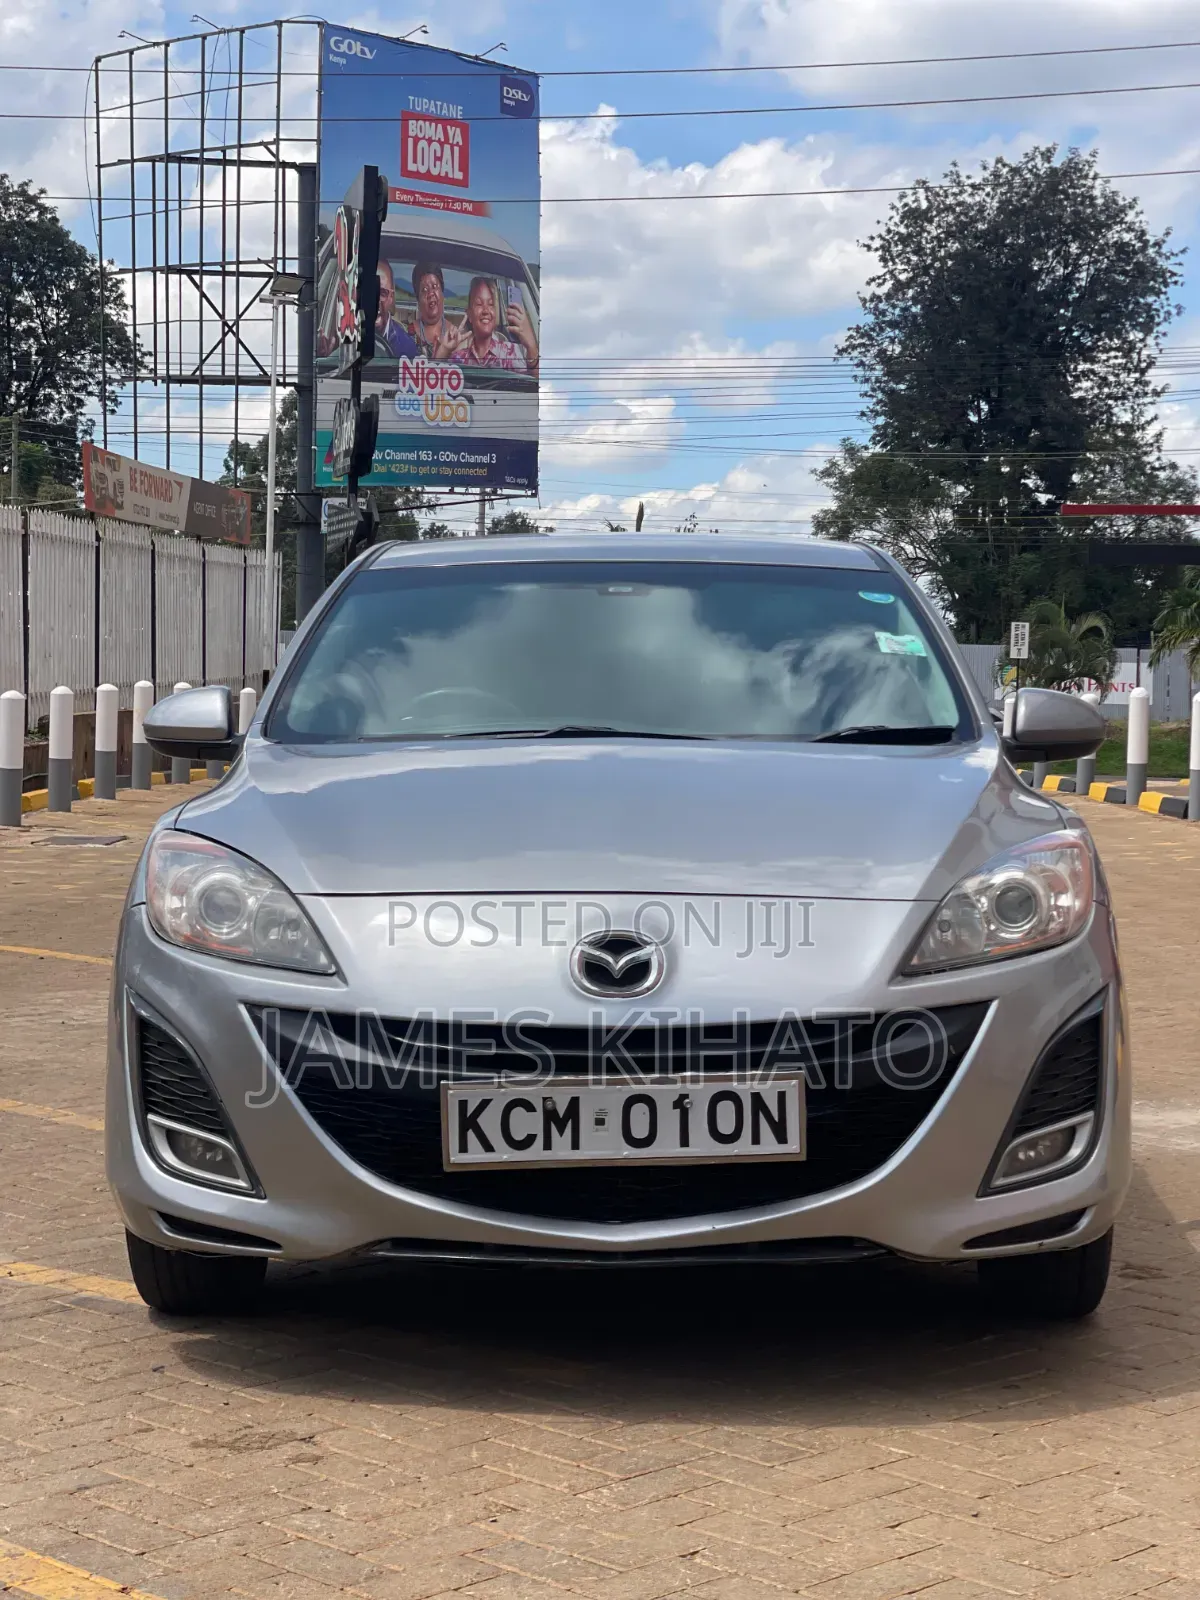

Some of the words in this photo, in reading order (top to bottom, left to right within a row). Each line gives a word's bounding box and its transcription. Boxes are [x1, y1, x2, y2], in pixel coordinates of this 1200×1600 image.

[330, 36, 377, 59] GOtv
[329, 53, 347, 67] Kenya
[503, 86, 530, 101] DStv
[408, 95, 463, 119] TUPATANE
[408, 119, 445, 142] BOMA
[447, 125, 463, 146] YA
[407, 137, 464, 180] LOCAL
[395, 190, 414, 204] Every
[415, 194, 444, 209] Thursday
[462, 202, 473, 212] PM
[402, 360, 462, 396] Njoro
[398, 395, 420, 412] wa
[424, 393, 468, 423] Uba
[385, 449, 417, 461] Channel
[418, 450, 432, 462] 163
[438, 451, 458, 463] GOtv
[459, 452, 490, 464] Channel
[491, 453, 497, 464] 3
[373, 463, 387, 473] Dial
[410, 464, 418, 474] to
[418, 465, 430, 476] get
[431, 466, 438, 475] or
[439, 466, 452, 476] stay
[453, 467, 488, 477] connected
[129, 466, 138, 494] BE
[140, 469, 174, 503] FORWARD
[457, 1095, 581, 1154] KCM
[620, 1090, 788, 1149] 010N
